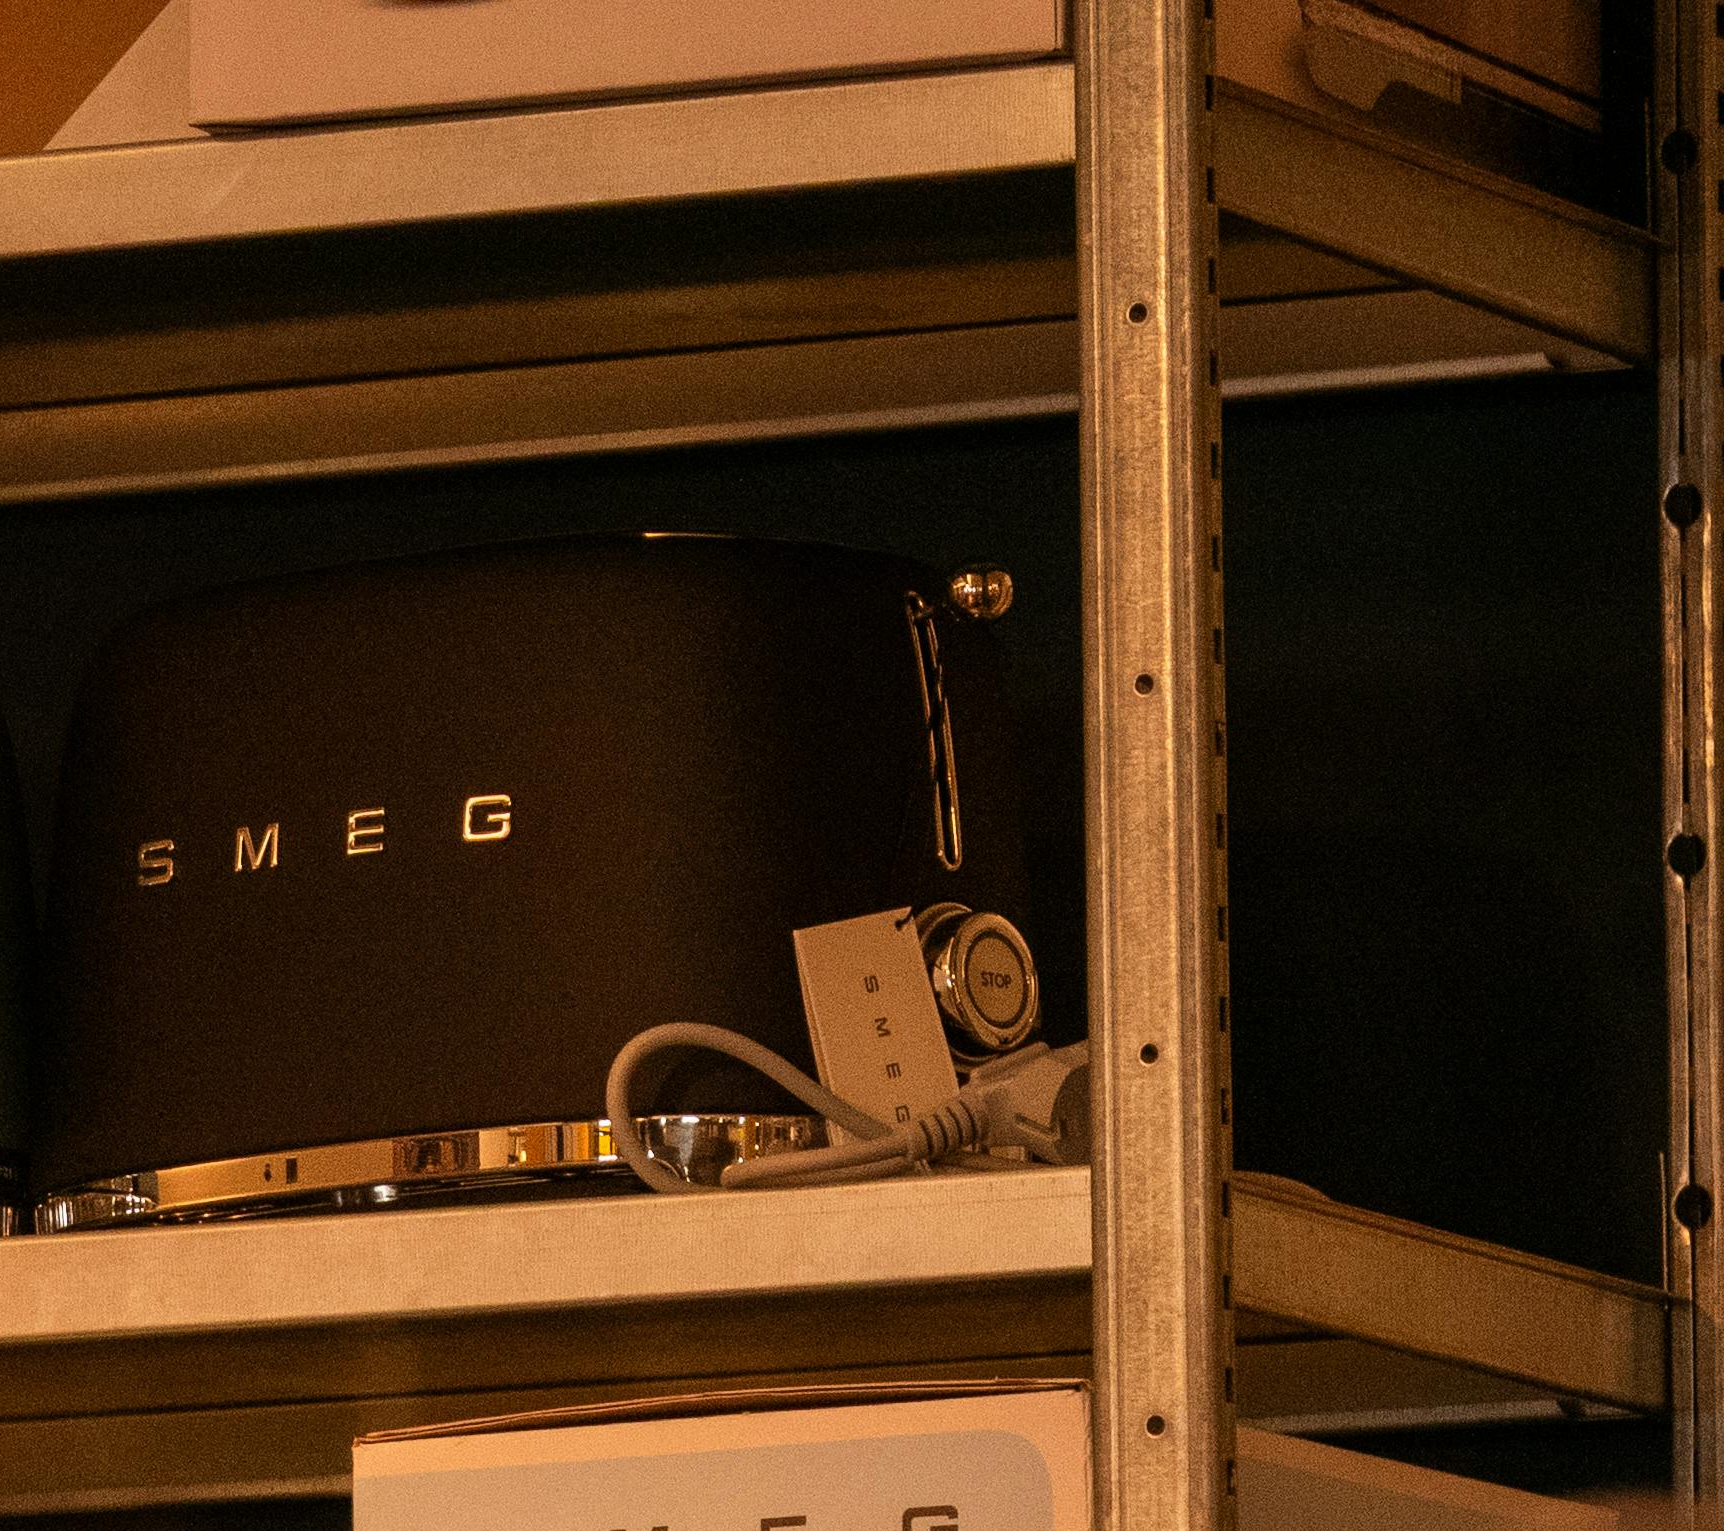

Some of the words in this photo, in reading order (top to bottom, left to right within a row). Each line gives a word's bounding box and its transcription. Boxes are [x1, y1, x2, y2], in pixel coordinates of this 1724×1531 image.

[137, 794, 513, 887] SMEG
[981, 972, 1012, 988] STOP
[863, 975, 911, 1124] SMEG
